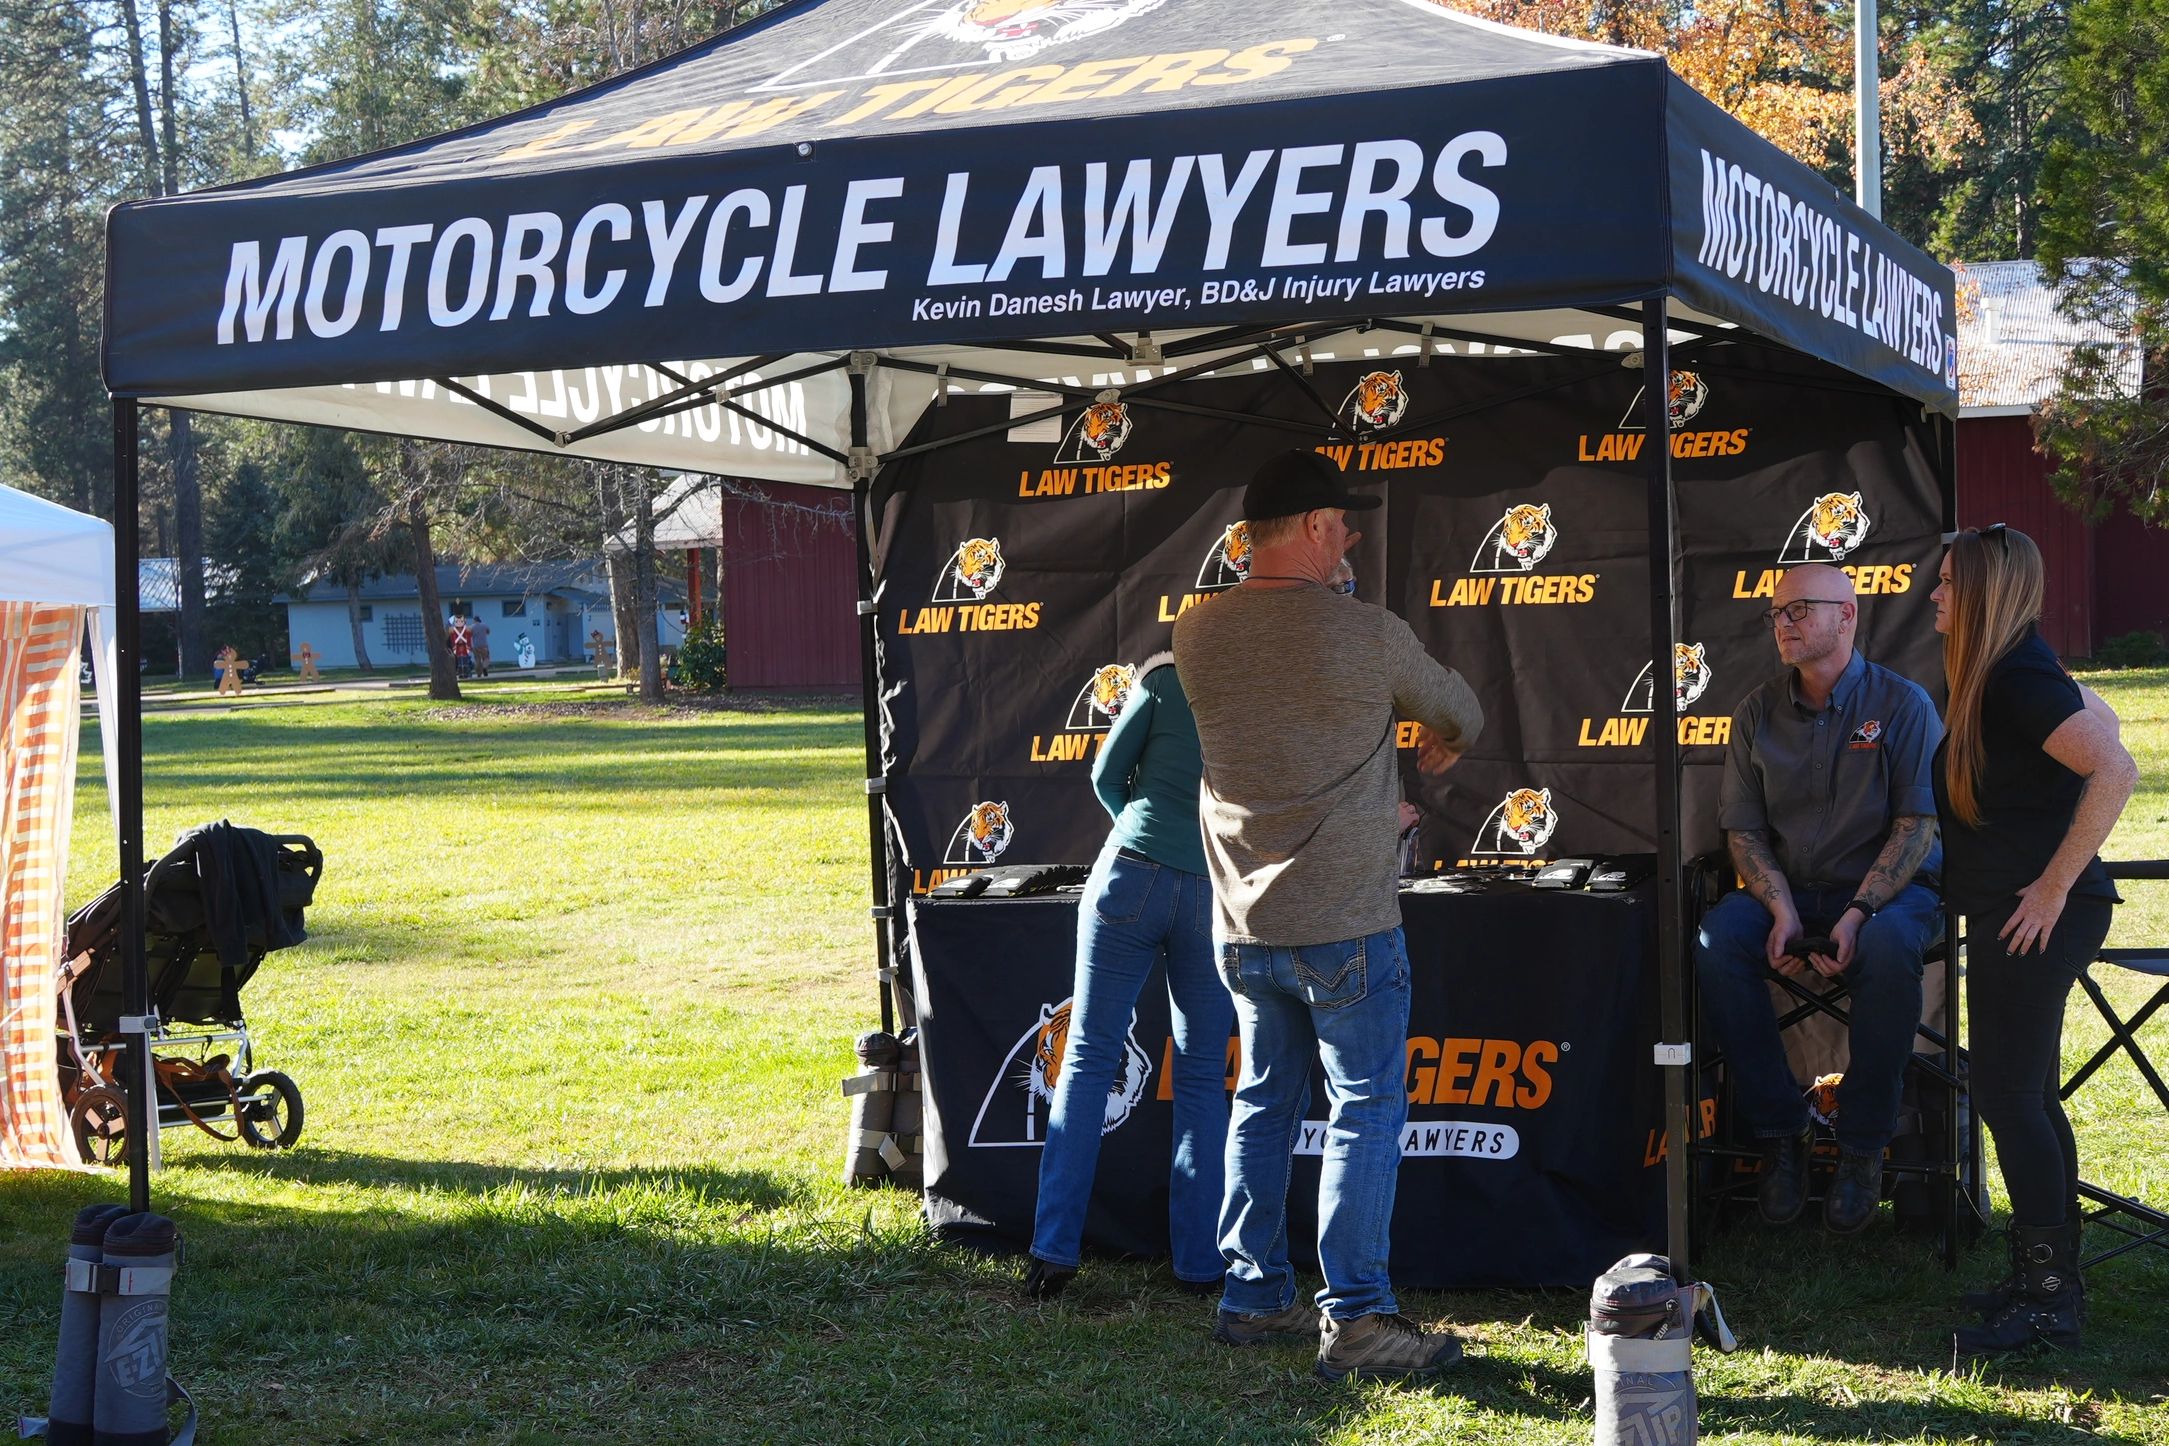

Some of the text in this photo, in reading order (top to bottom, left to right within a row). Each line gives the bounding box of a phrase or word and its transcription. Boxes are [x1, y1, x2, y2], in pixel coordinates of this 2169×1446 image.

[490, 37, 1320, 163] LAW TIGERS
[215, 130, 1508, 346] MOTORCYCLE LAWYERS
[1698, 148, 1944, 375] MOTORCYCLE LAWYERS
[912, 269, 1486, 321] Kevin Danesh Lawyer, BD&J Injury Lawyers
[1358, 437, 1446, 471] TIGERS
[1578, 433, 1646, 462] LAW
[1018, 461, 1171, 497] LAW TIGERS
[1429, 573, 1596, 607] LAW TIGERS
[898, 601, 1041, 635] LAW TIGERS
[1030, 733, 1091, 762] LAW
[1578, 717, 1649, 746] LAW
[1404, 1128, 1505, 1153] AWYERS
